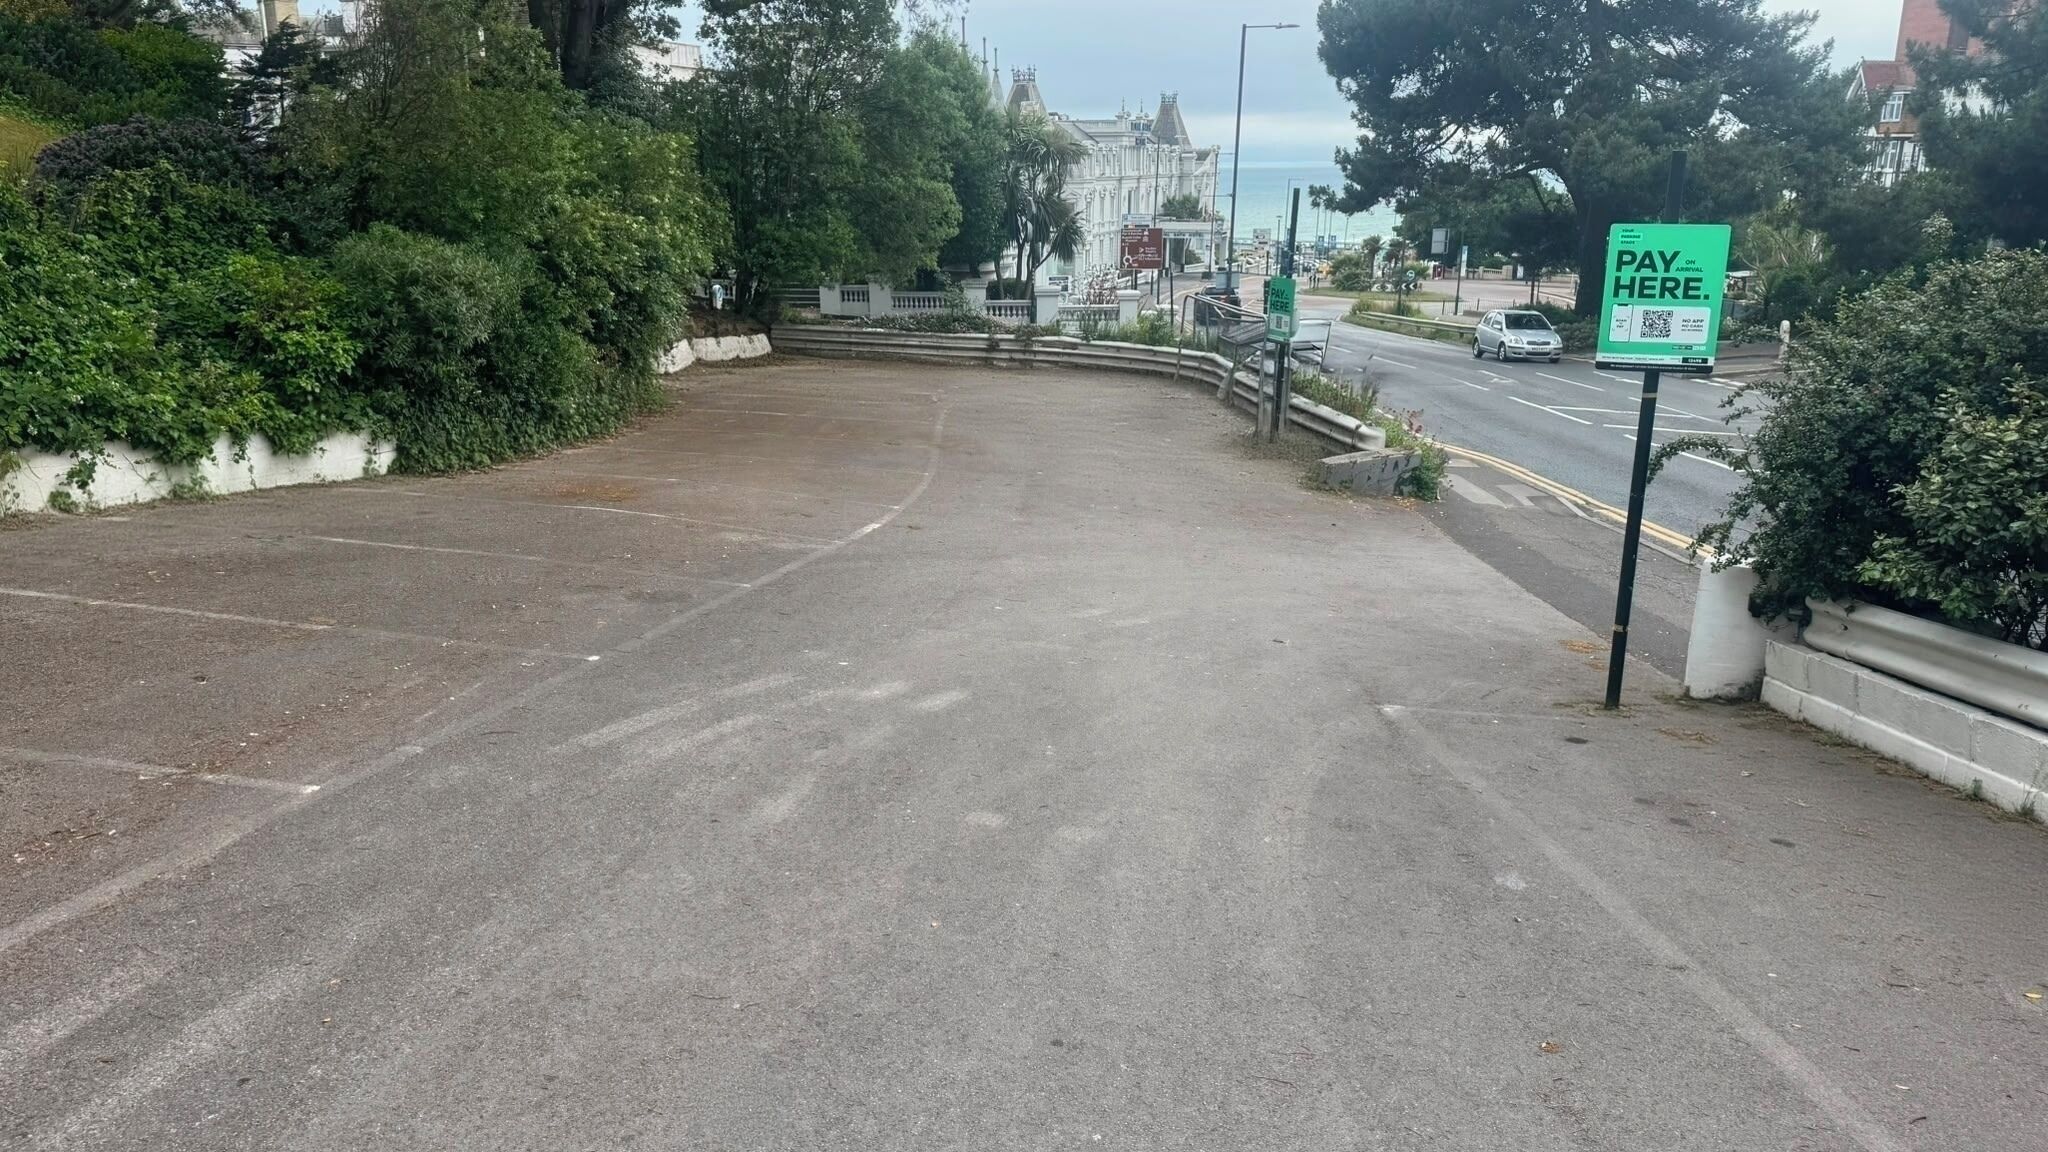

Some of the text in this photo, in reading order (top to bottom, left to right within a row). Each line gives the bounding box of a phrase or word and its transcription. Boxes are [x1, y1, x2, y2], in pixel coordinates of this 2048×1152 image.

[1615, 249, 1681, 273] PAY
[1271, 288, 1285, 300] PAY
[1612, 276, 1710, 300] HERE.
